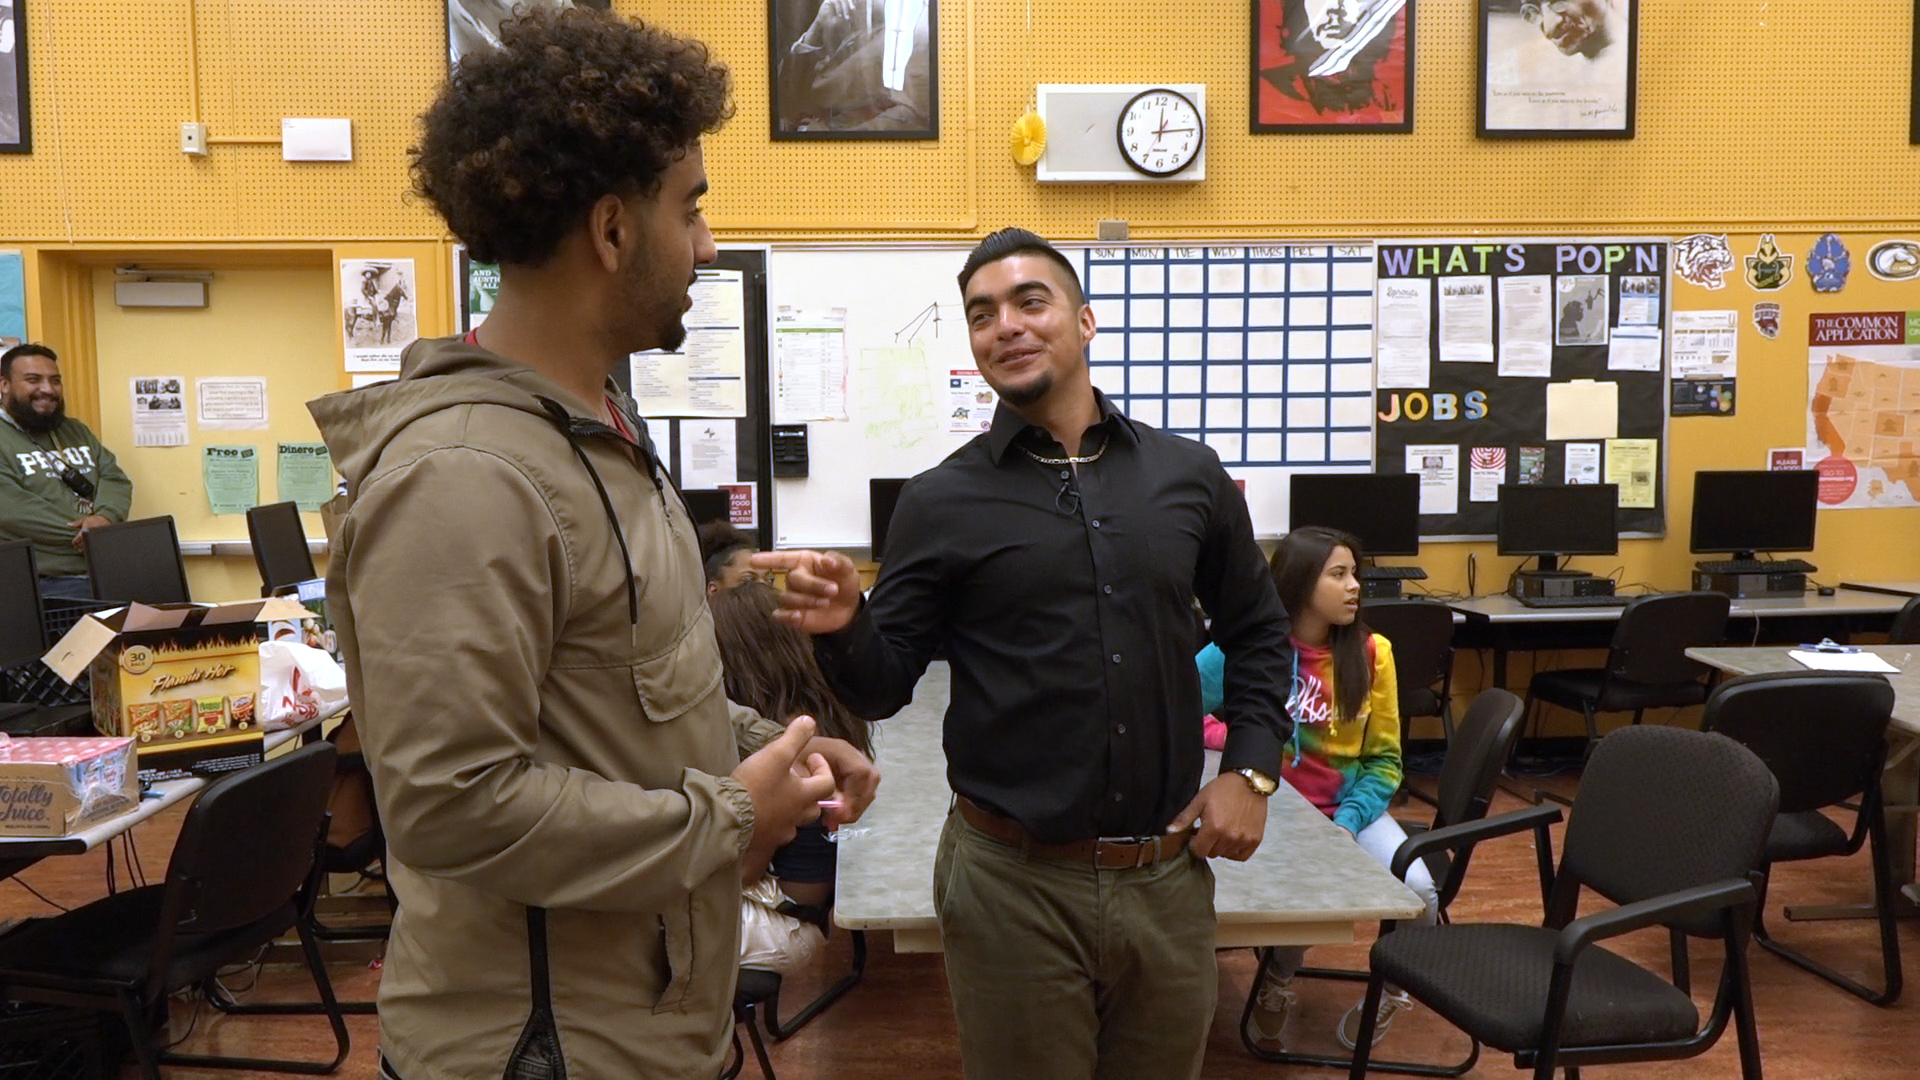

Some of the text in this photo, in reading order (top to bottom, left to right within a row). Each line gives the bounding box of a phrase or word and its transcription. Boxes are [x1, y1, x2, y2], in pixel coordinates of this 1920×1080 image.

[1142, 101, 1151, 110] 11
[1155, 97, 1168, 106] 12
[1174, 102, 1178, 111] 1
[1126, 127, 1134, 137] 9
[1130, 143, 1138, 152] 8
[1181, 142, 1188, 152] 4
[1142, 154, 1149, 164] 7
[1155, 159, 1163, 168] 6
[1171, 154, 1179, 164] 5
[1095, 246, 1365, 259] SUN MON TUE WED THURS FRI SAT
[1382, 244, 1658, 276] WHAT'S POP'N
[1815, 315, 1899, 329] THE COMMON
[1815, 327, 1899, 342] APPLICATION
[1378, 390, 1488, 423] JOBS
[207, 447, 238, 456] Free
[279, 445, 314, 454] Dinero
[130, 653, 146, 662] 30
